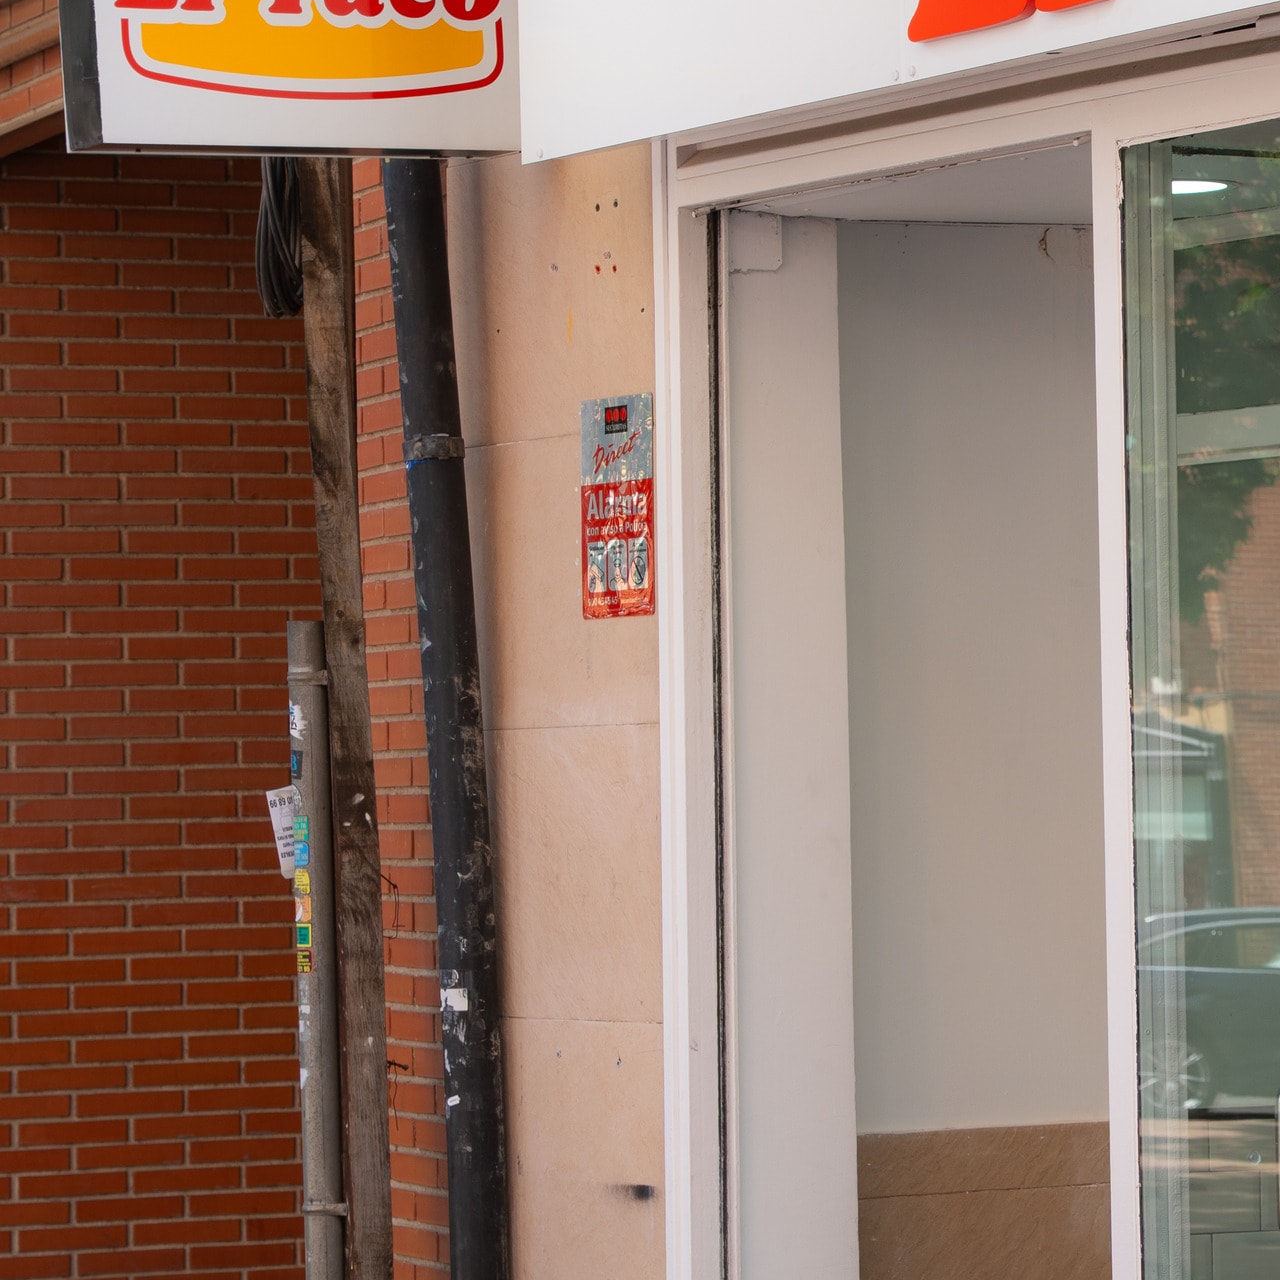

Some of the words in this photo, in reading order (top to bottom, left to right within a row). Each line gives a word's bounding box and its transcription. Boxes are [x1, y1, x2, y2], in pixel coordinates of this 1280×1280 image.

[593, 431, 641, 474] Direct
[587, 489, 647, 520] Alarma
[586, 526, 599, 536] con
[600, 522, 618, 535] aviso
